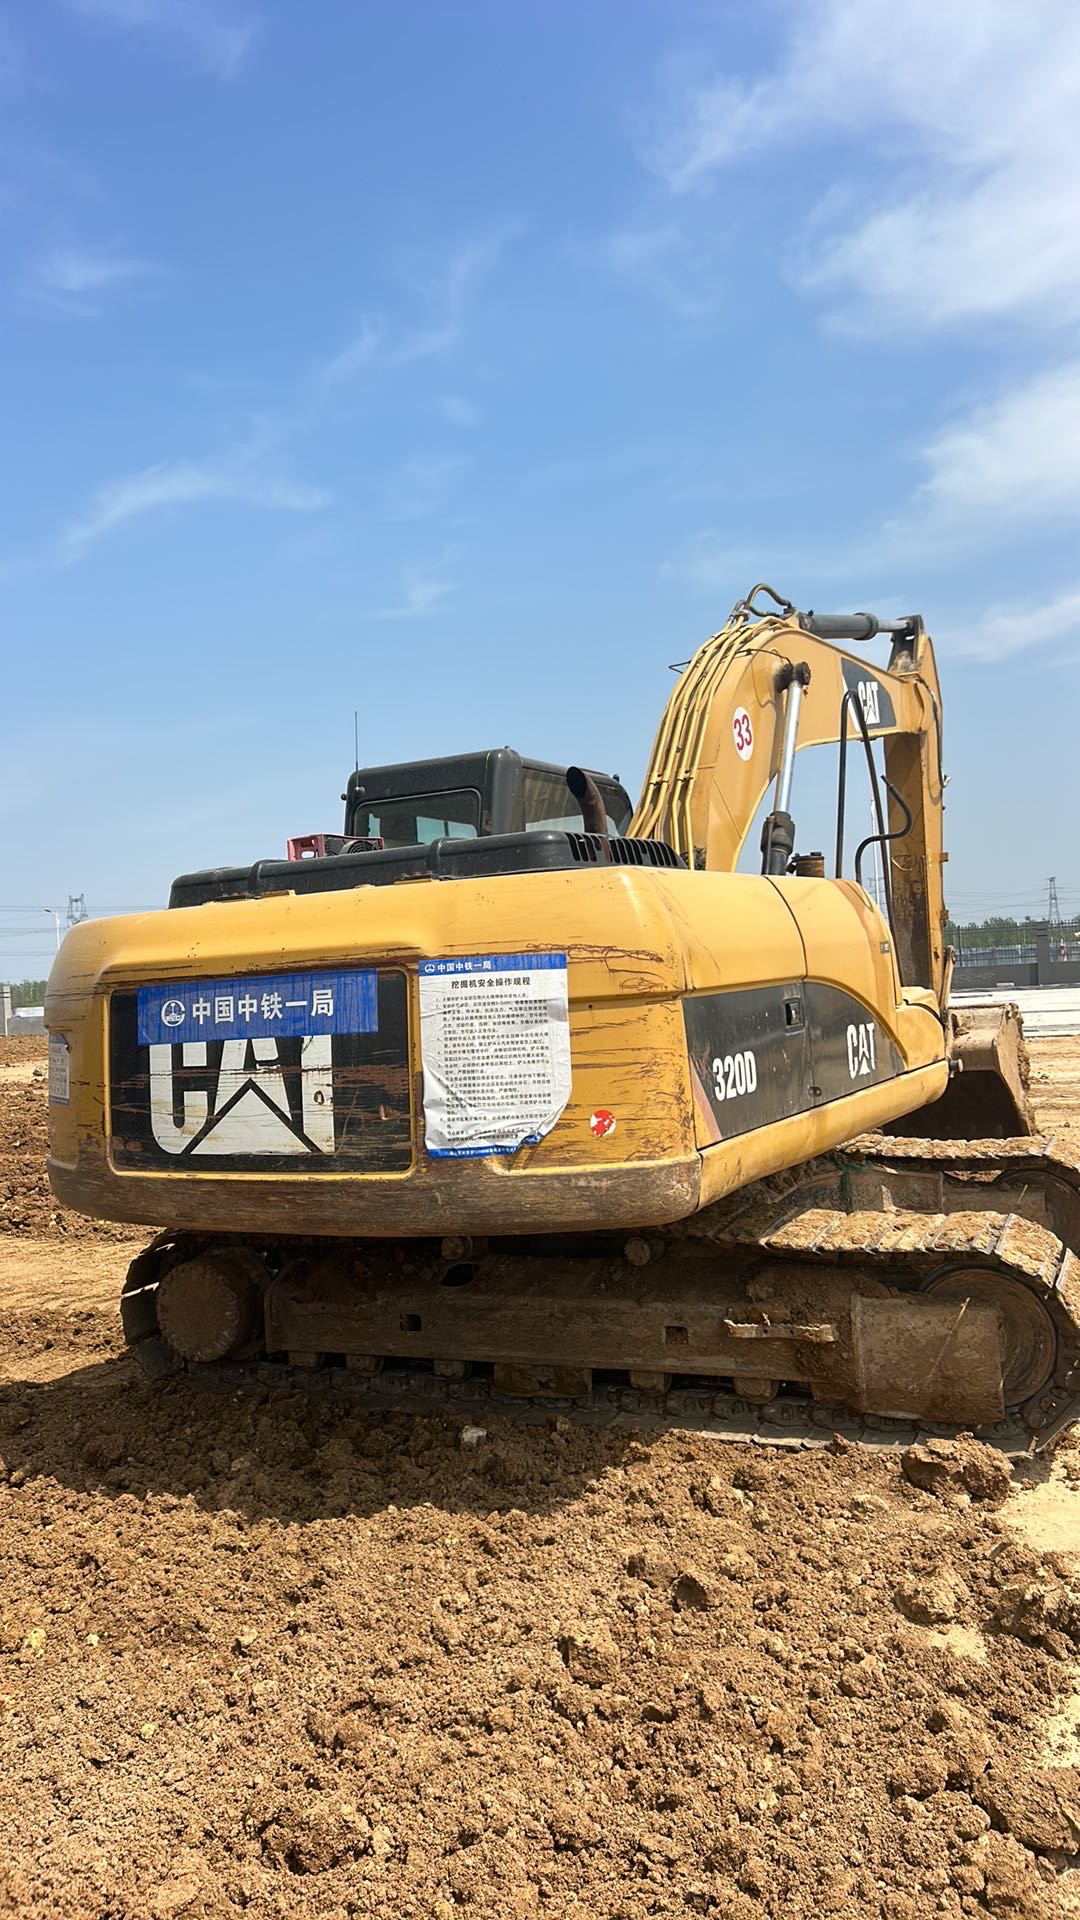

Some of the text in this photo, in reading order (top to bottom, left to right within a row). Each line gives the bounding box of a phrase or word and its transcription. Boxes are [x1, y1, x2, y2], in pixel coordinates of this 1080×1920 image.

[858, 681, 880, 724] CAT
[733, 714, 752, 751] 33
[437, 961, 492, 973] 中国中铁一局
[451, 977, 531, 989] 挖掘机安全操作规程
[192, 989, 334, 1025] 中国中铁一局
[846, 1022, 876, 1079] CAT
[712, 1050, 757, 1101] 320D
